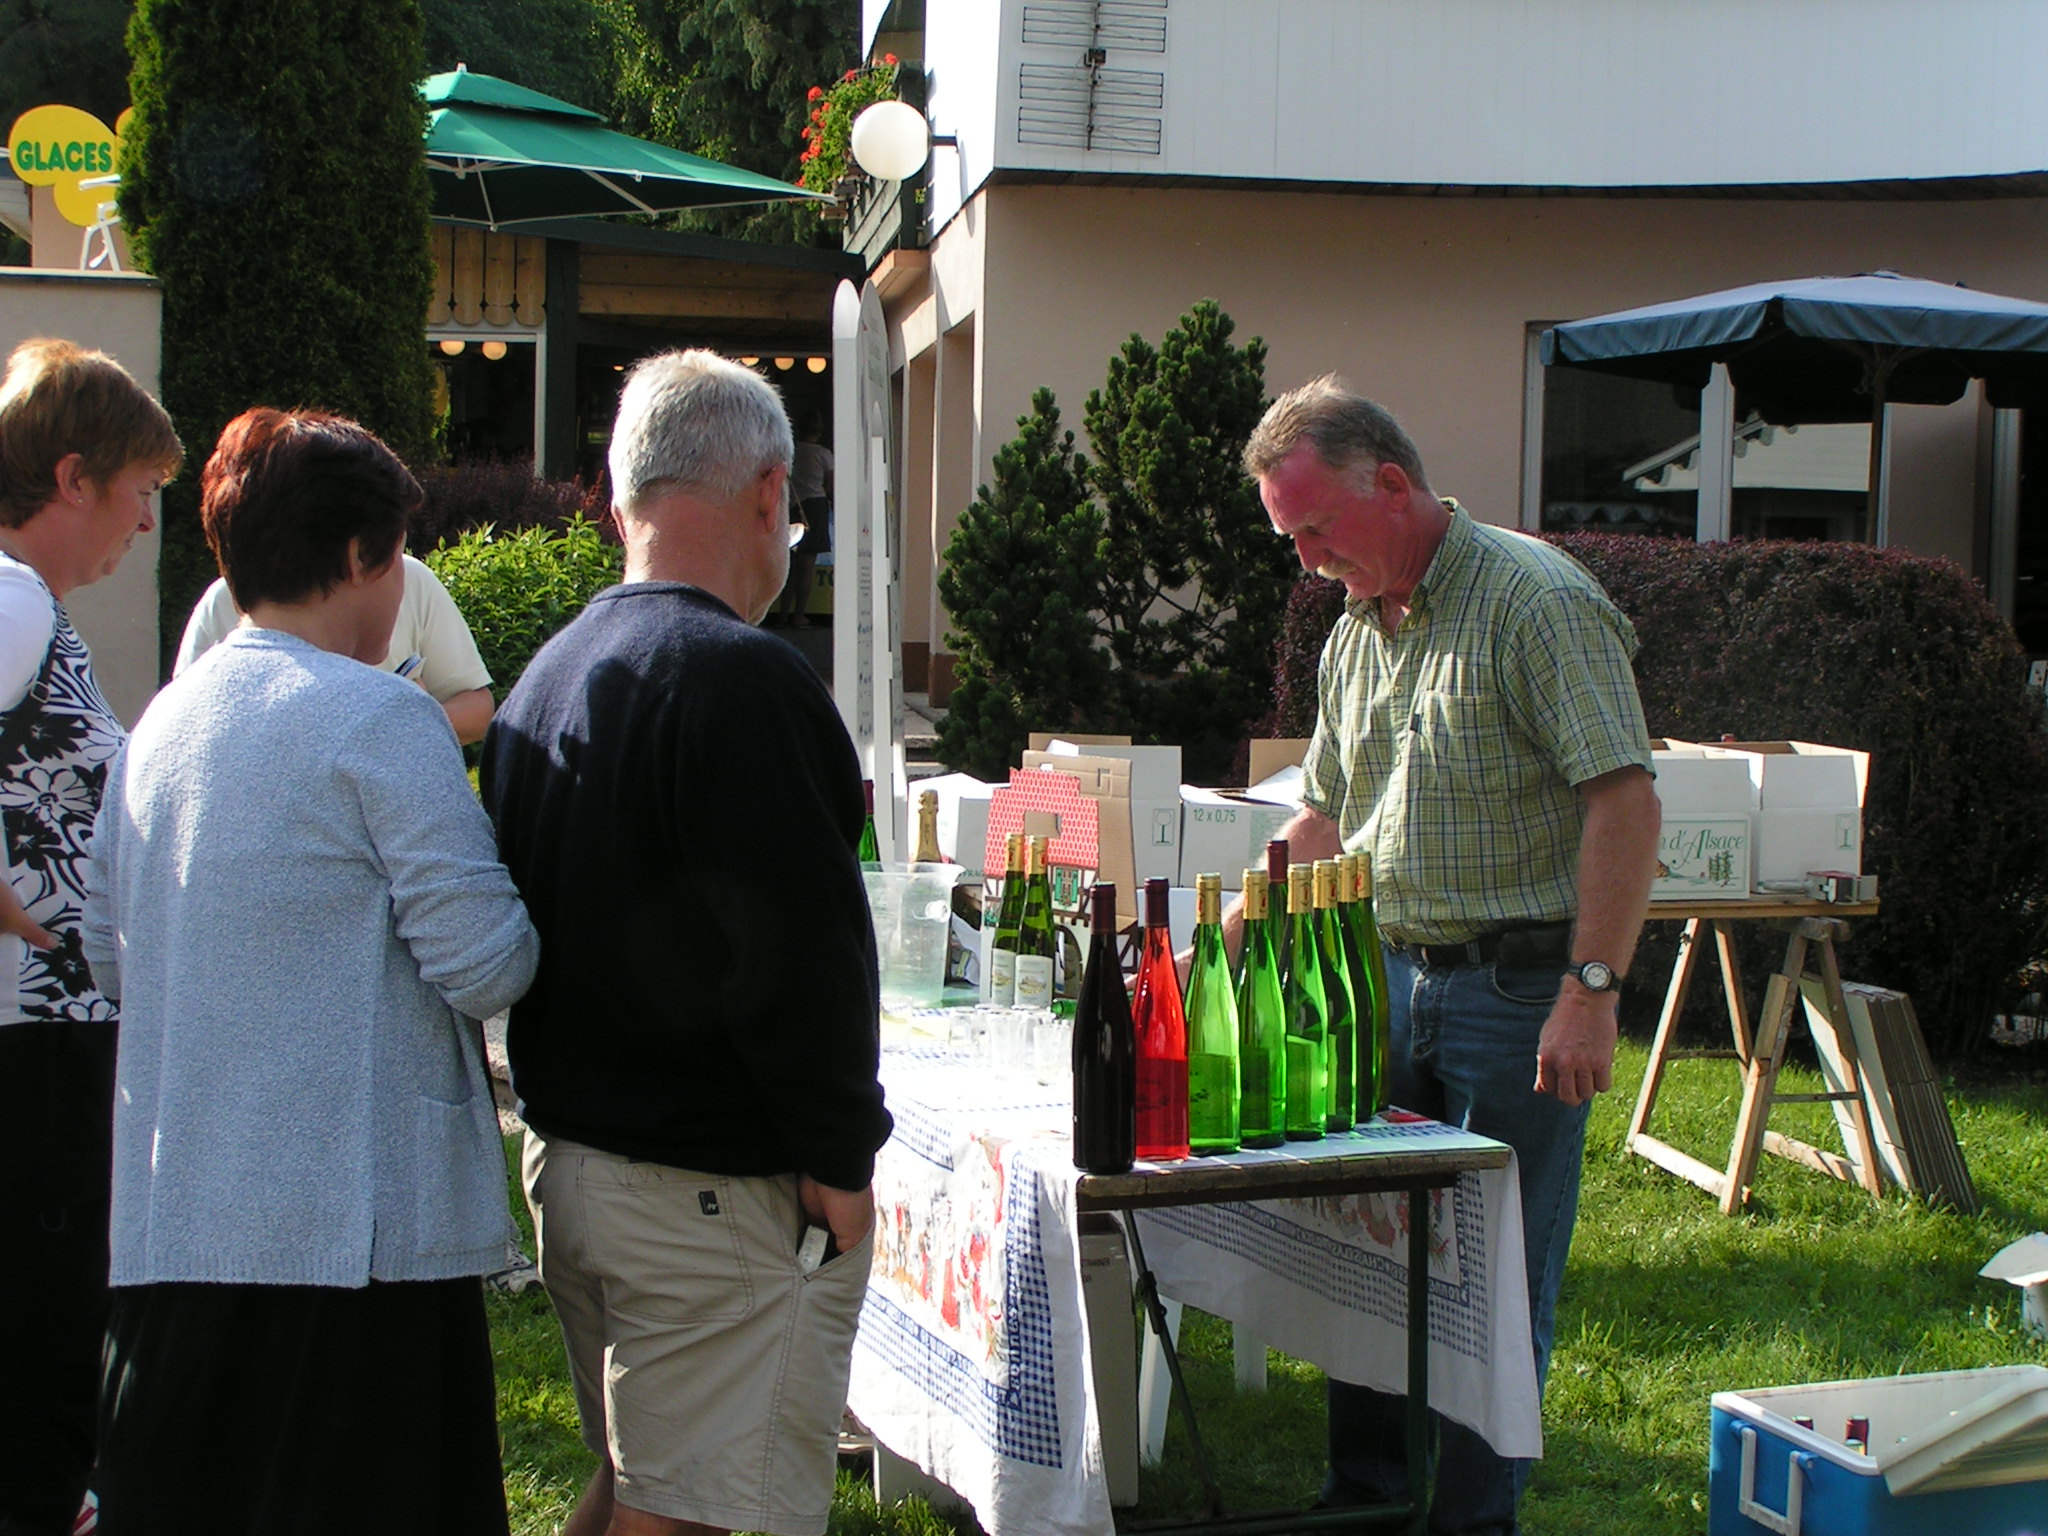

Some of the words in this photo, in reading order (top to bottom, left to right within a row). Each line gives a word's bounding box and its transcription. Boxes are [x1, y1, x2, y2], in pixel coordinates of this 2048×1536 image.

[16, 140, 112, 172] GLACES
[1193, 808, 1204, 821] 12
[1669, 829, 1743, 869] d'Alsace
